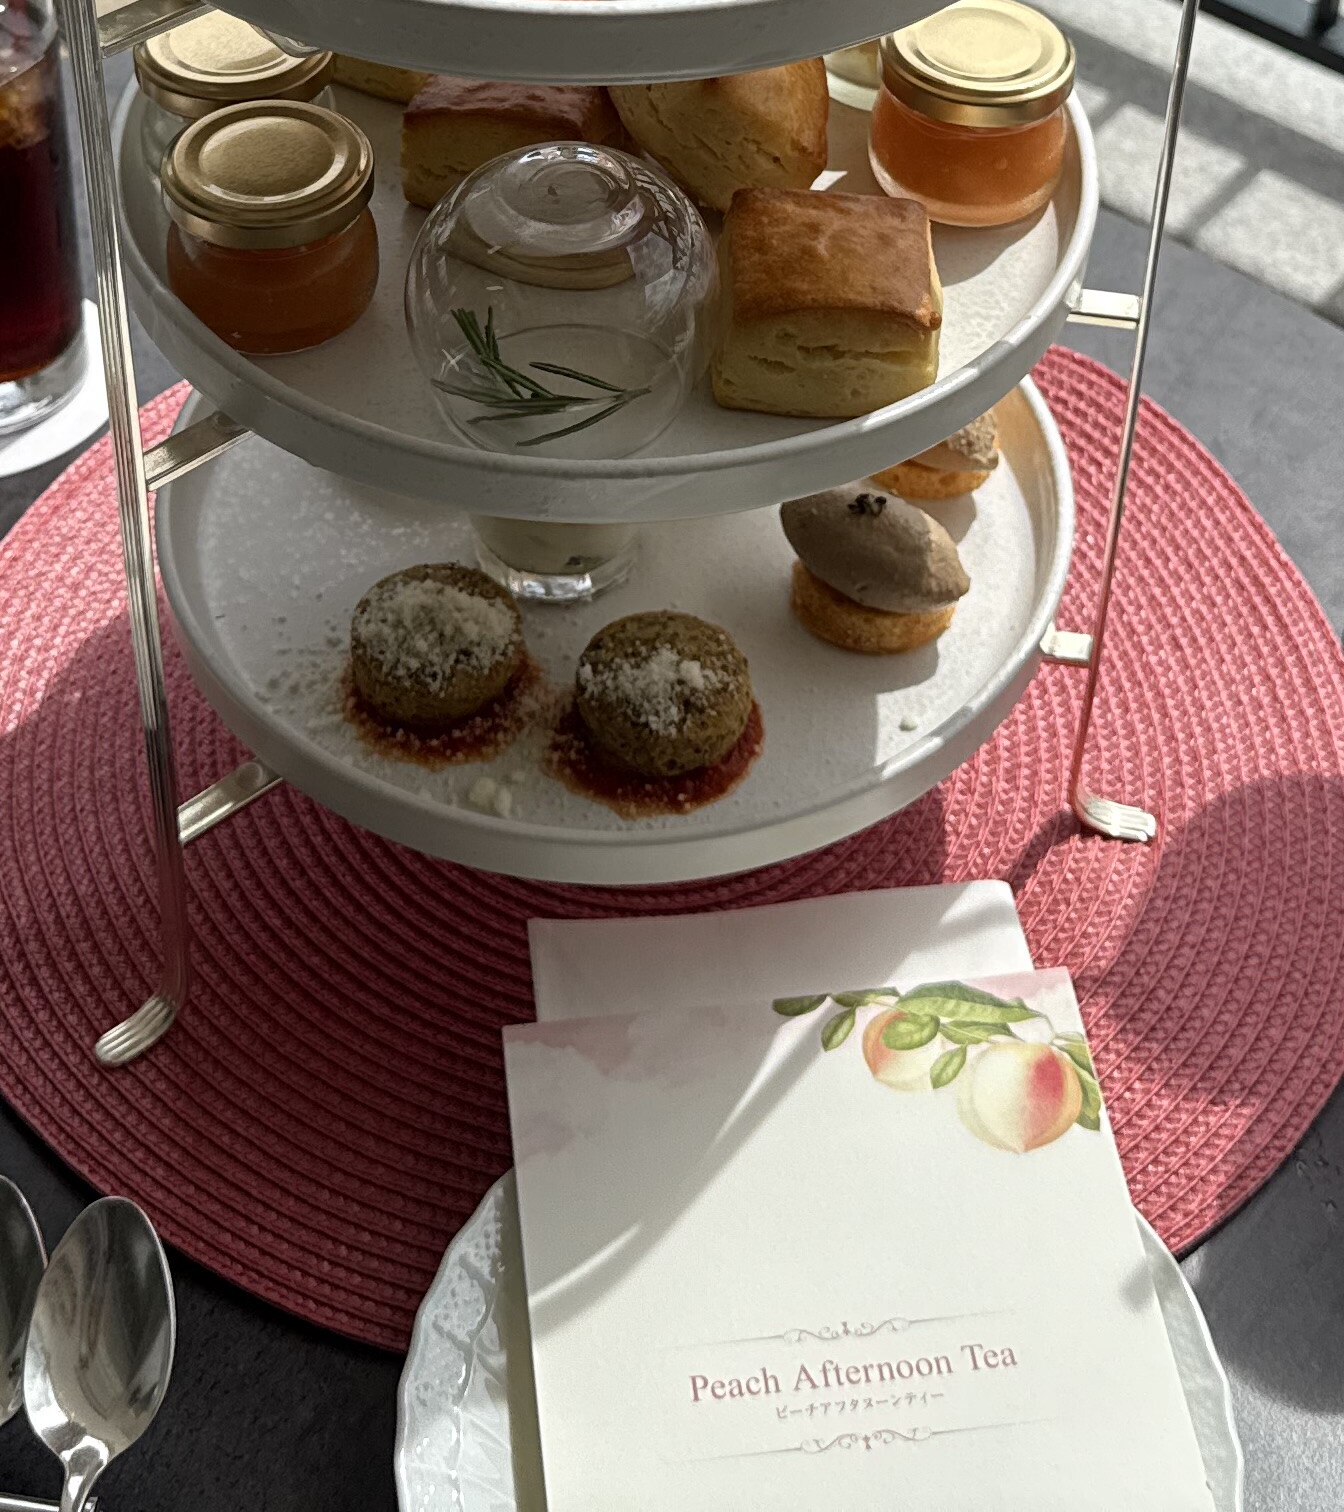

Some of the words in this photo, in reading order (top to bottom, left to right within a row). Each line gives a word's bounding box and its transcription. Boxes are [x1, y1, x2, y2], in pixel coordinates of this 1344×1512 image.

[689, 1367, 782, 1403] Peach
[793, 1353, 954, 1392] Afternoon
[960, 1344, 1019, 1371] Tea
[775, 1391, 945, 1420] ピーチアフタヌーンティー
